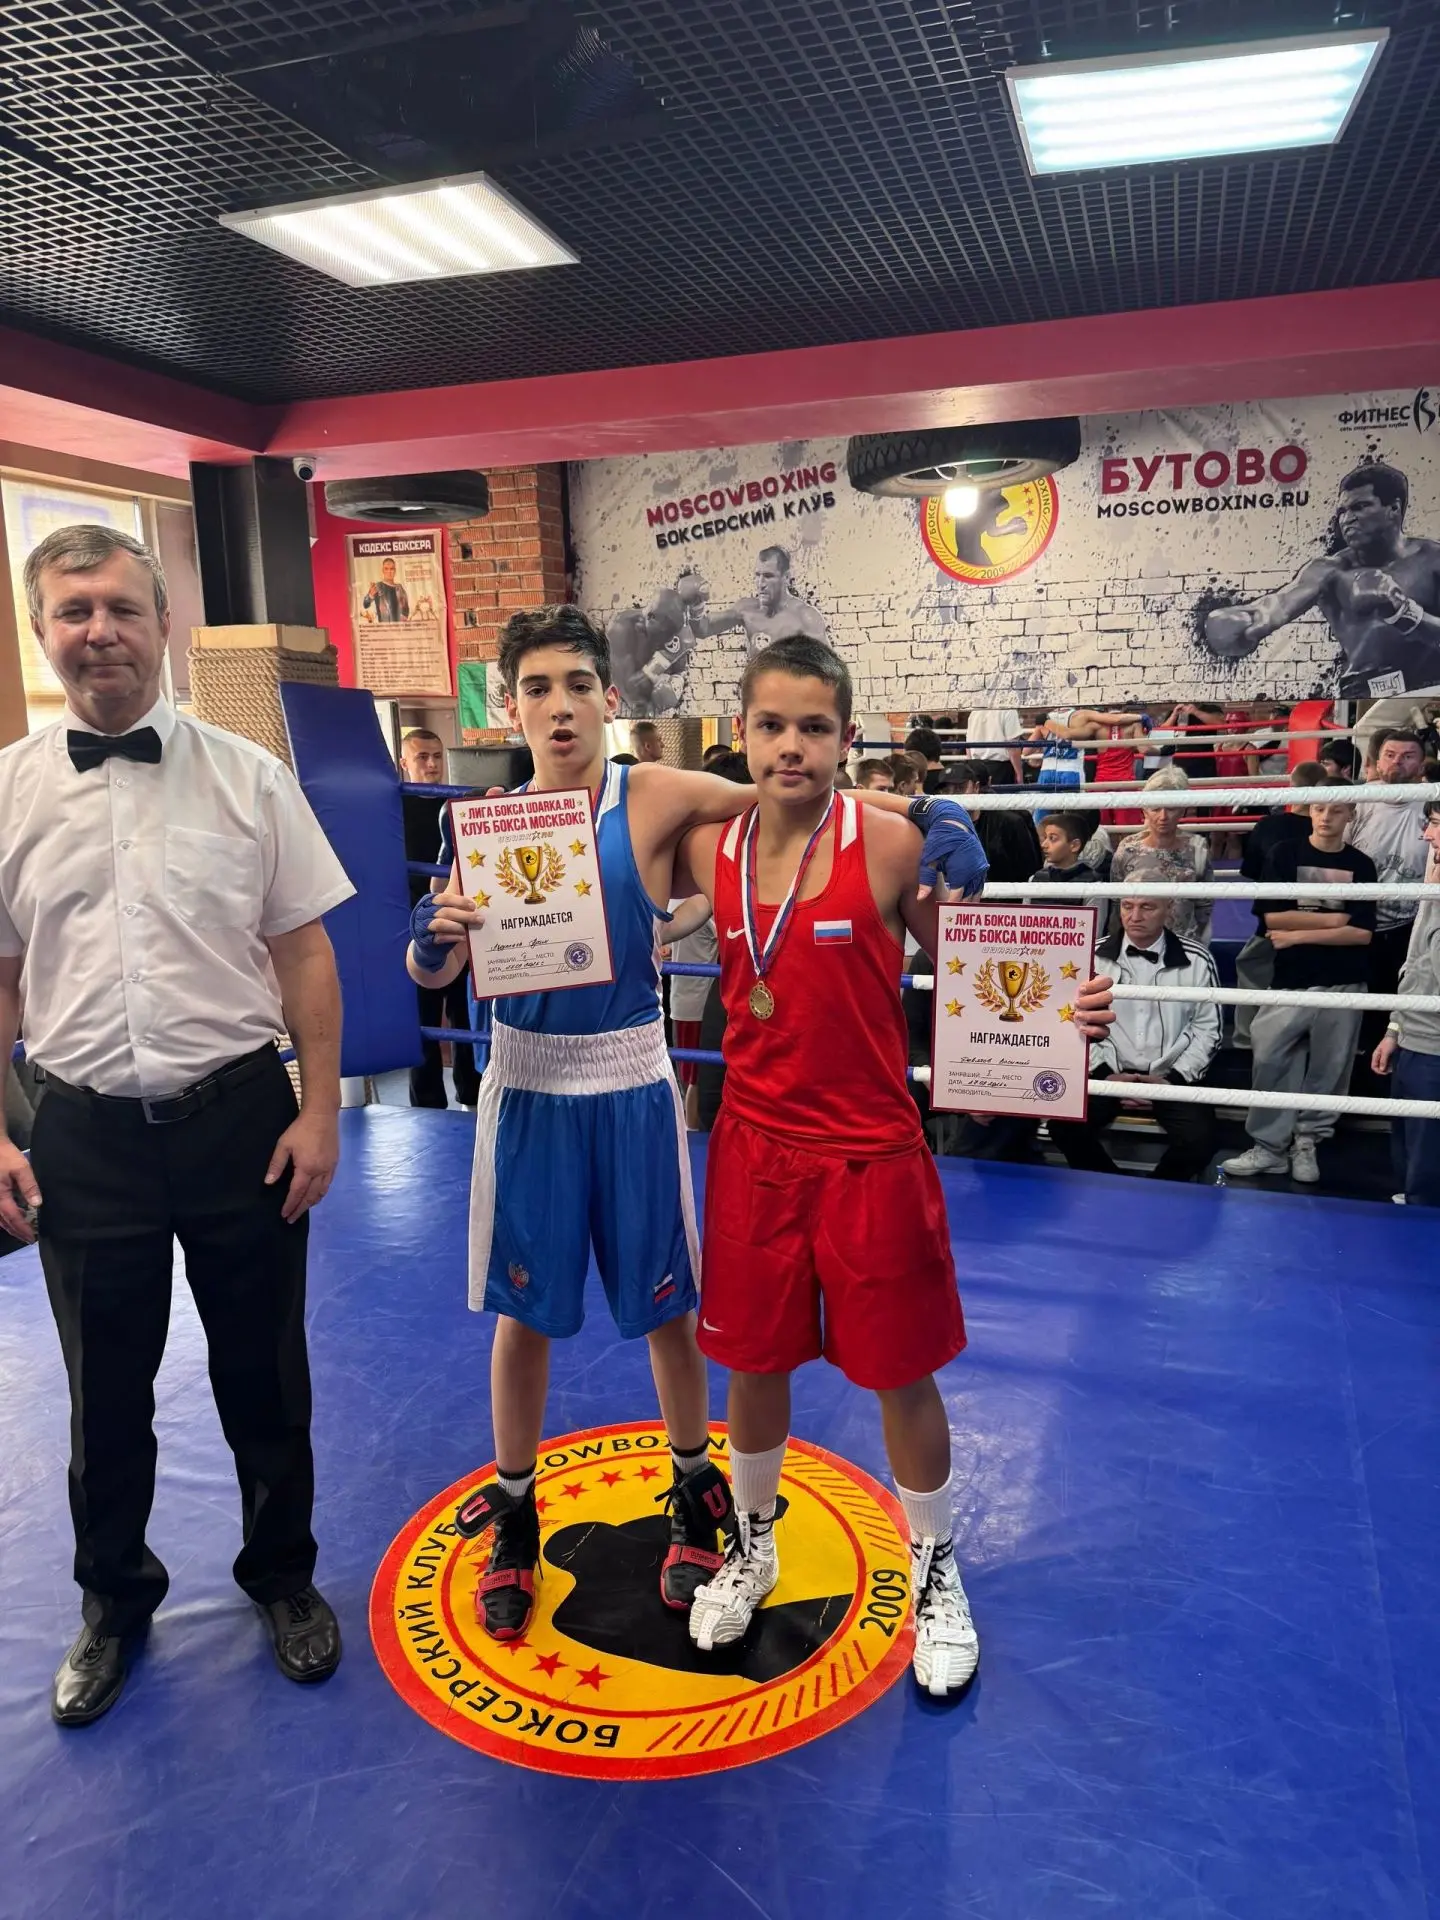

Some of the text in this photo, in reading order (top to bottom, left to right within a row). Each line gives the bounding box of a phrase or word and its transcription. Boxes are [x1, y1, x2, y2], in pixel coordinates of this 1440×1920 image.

[1338, 405, 1411, 424] ФИТНЕС
[1101, 445, 1308, 495] БУТОВО
[646, 461, 837, 528] MOSCOWBOXING
[1097, 491, 1309, 519] MOSCOWBOXING.RU
[655, 491, 836, 549] БОКСЕРСКИЙ КЛУБ
[359, 540, 432, 554] КОДЕКС БОКСЕРА
[980, 567, 1005, 579] 2009
[468, 798, 576, 819] ЛИГА БОКСА UDARKA.RU
[460, 811, 586, 836] КЛУБ БОКСА МОСКБОКС
[500, 911, 573, 930] НАГРАЖДАЕТСЯ
[955, 913, 1077, 929] ЛИГА БОКСА UDARKA.RU
[945, 928, 1085, 946] КЛУБ БОКСА МОСКБОКС
[970, 1032, 1050, 1047] НАГРАЖДАЕТСЯ
[948, 1088, 992, 1097] РУКОВОДИТЕЛЬ
[859, 1569, 907, 1637] 2009
[398, 1522, 621, 1748] БОКСЕРСКИЙ КЛУБ
